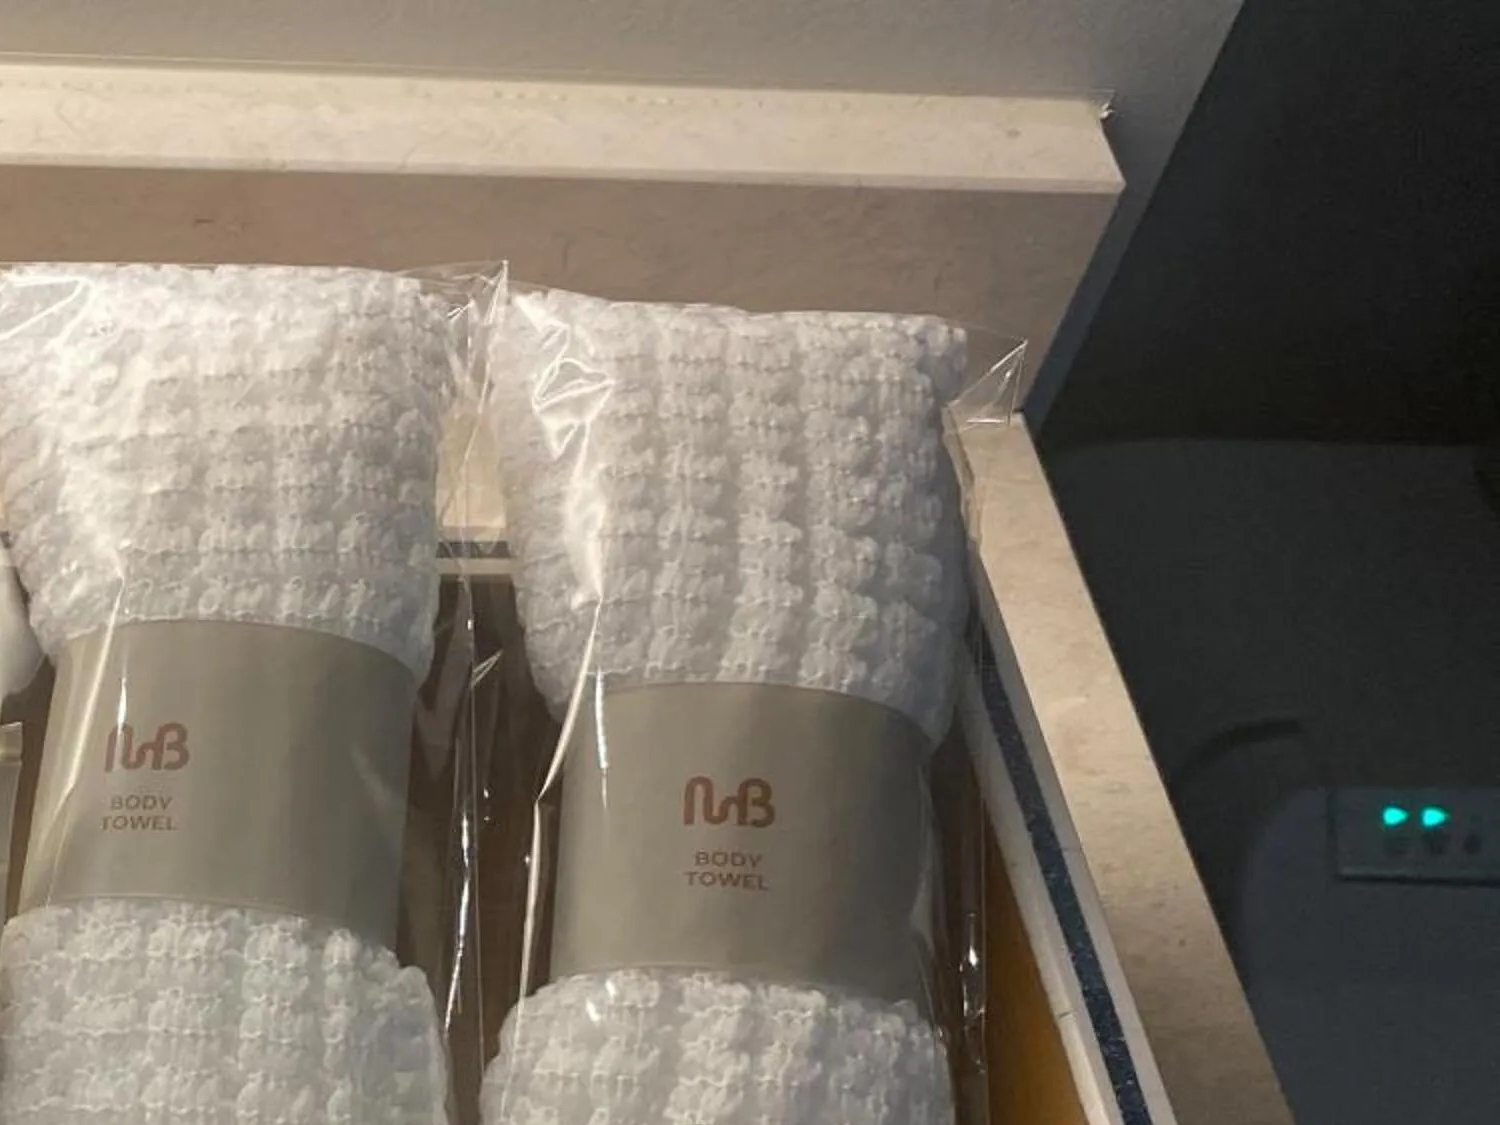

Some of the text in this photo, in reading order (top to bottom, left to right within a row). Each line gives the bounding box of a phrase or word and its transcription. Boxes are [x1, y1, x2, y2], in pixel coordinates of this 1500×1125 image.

[110, 795, 173, 811] BODY
[101, 815, 179, 831] TOWEL
[694, 851, 763, 868] BODY
[684, 872, 769, 890] TOWEL
